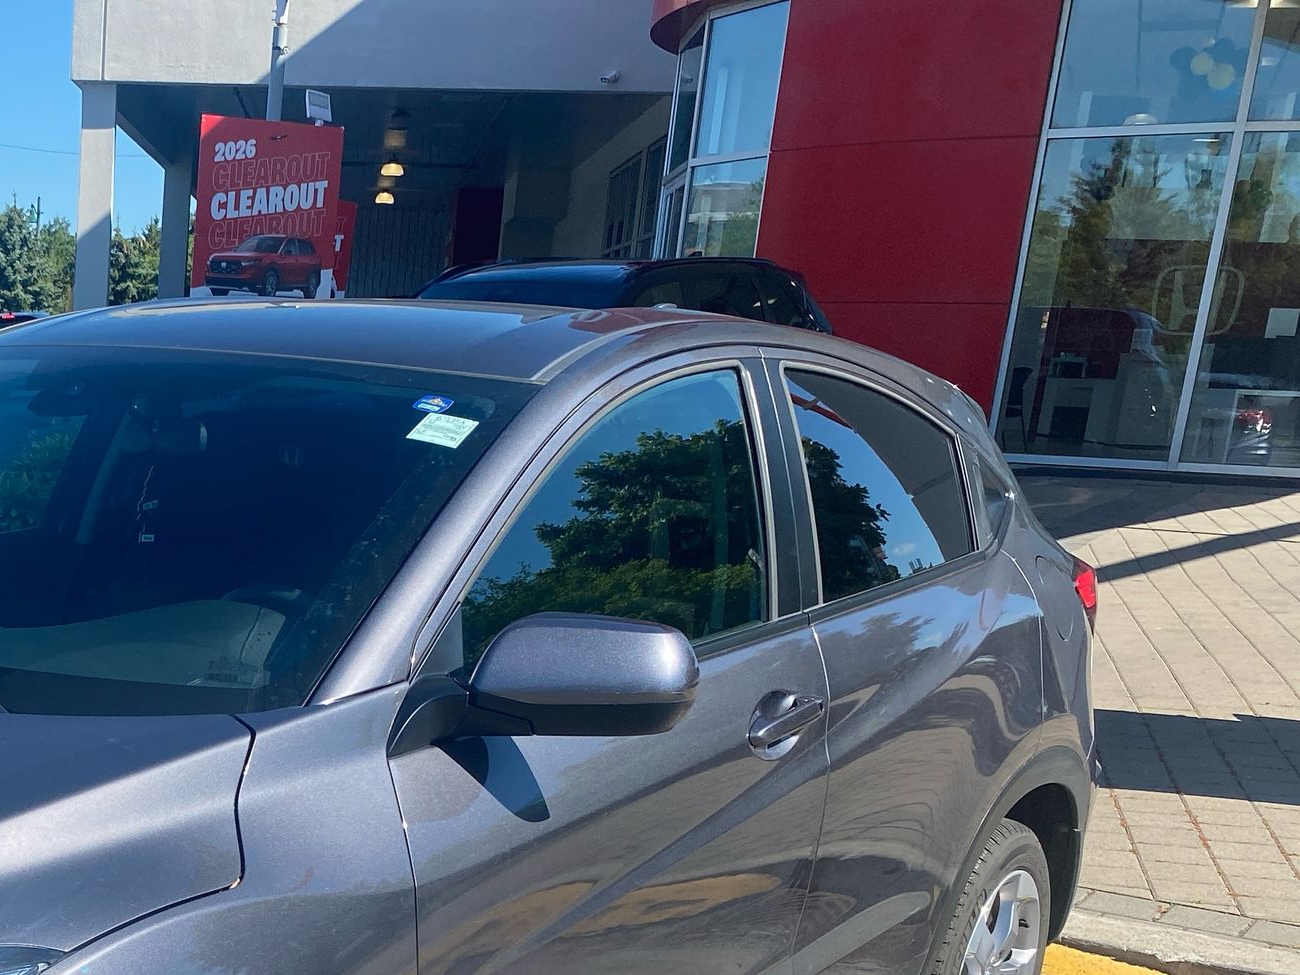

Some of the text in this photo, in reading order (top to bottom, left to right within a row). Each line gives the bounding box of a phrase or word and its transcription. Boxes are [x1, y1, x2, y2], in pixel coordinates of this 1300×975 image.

[214, 139, 257, 163] 2026
[212, 152, 331, 191] CLEAROUT
[210, 180, 329, 221] CLEAROUT
